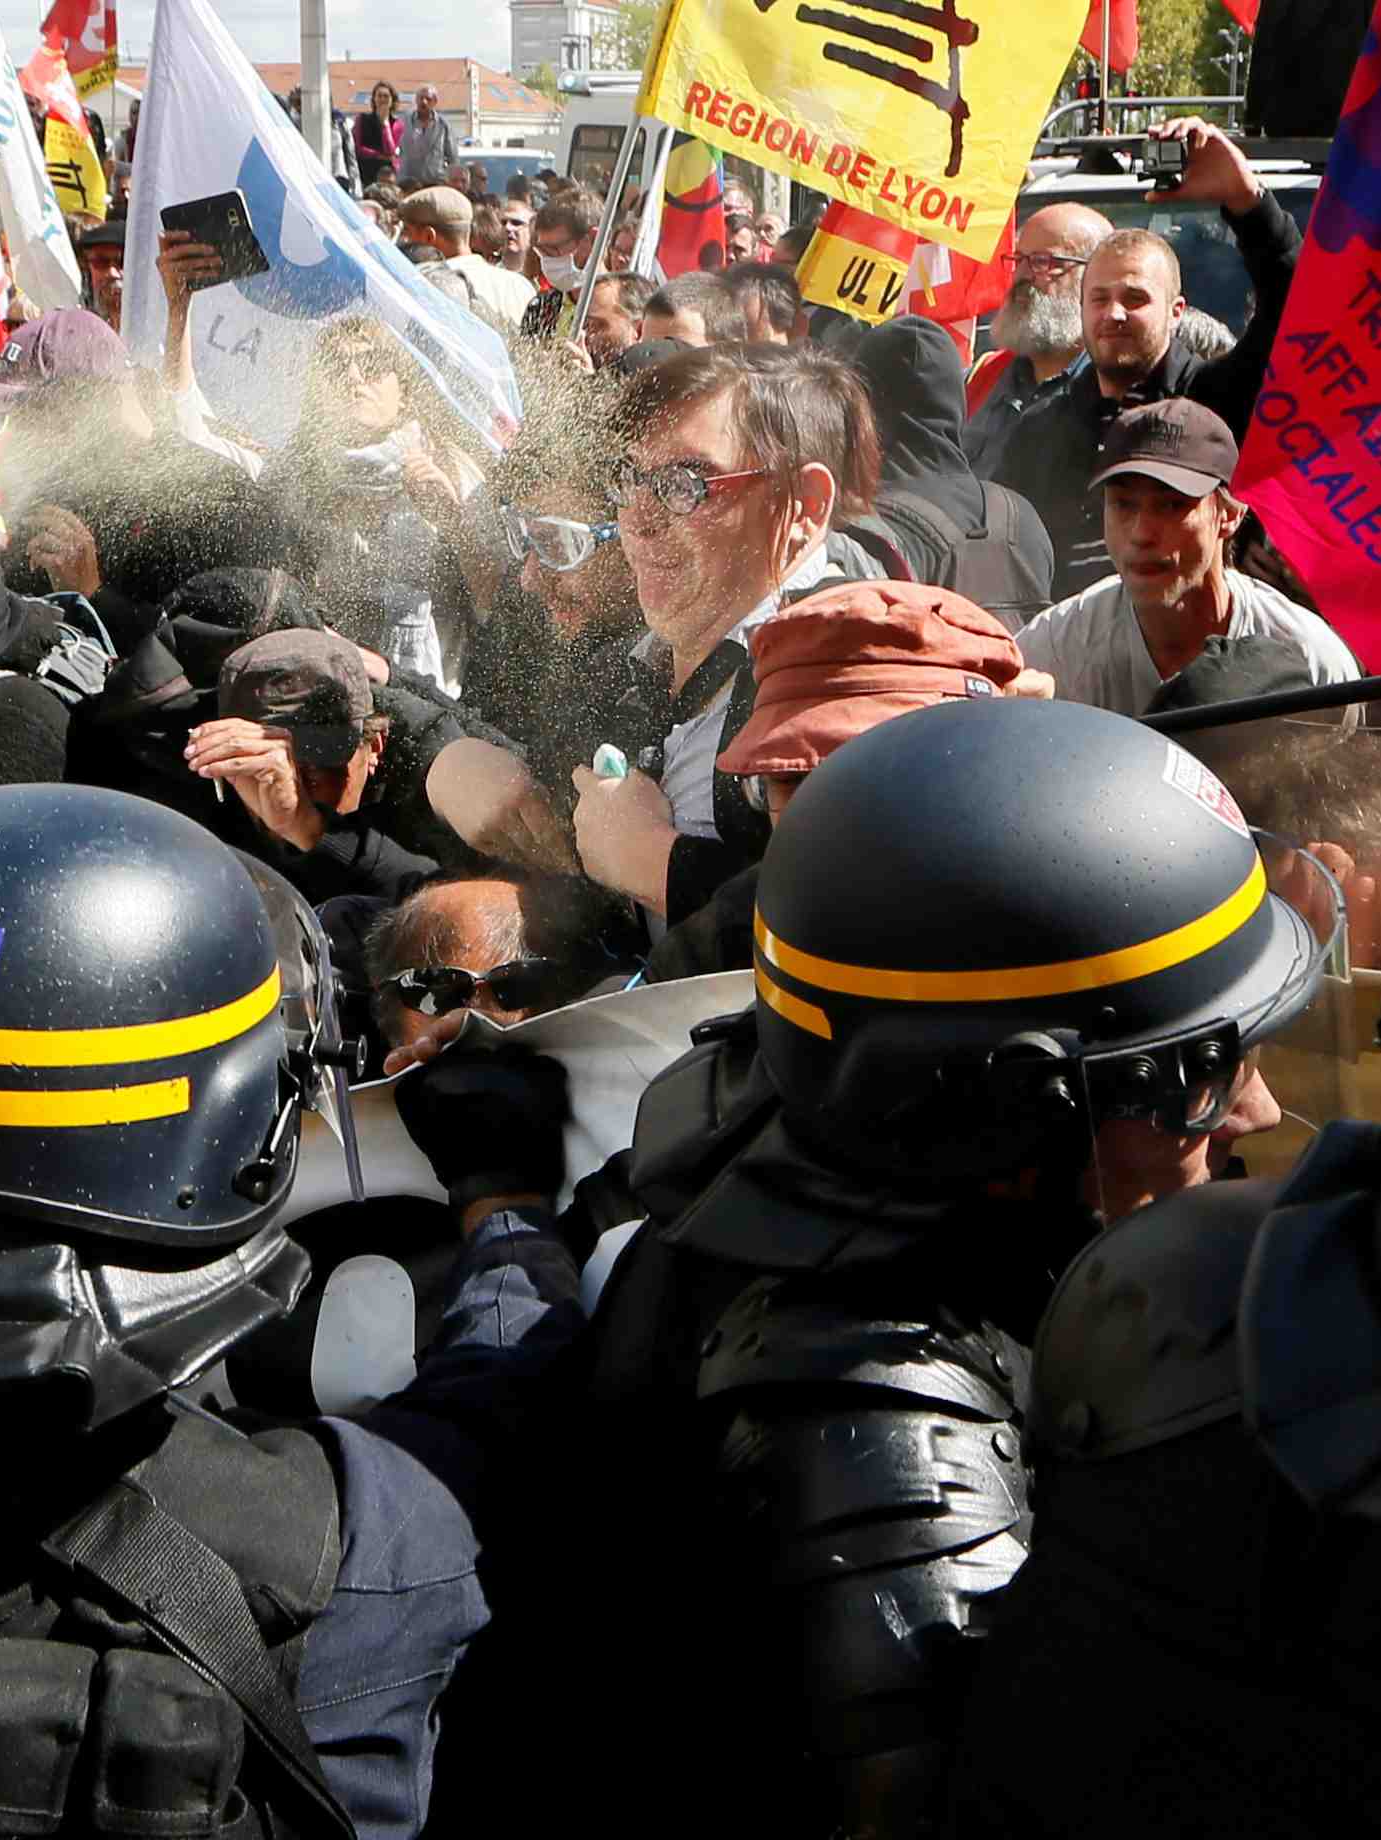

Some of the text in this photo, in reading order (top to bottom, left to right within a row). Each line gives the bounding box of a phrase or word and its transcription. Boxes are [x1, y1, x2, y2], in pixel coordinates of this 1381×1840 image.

[683, 81, 975, 233] RÉGION DE LYON
[836, 256, 877, 306] UL
